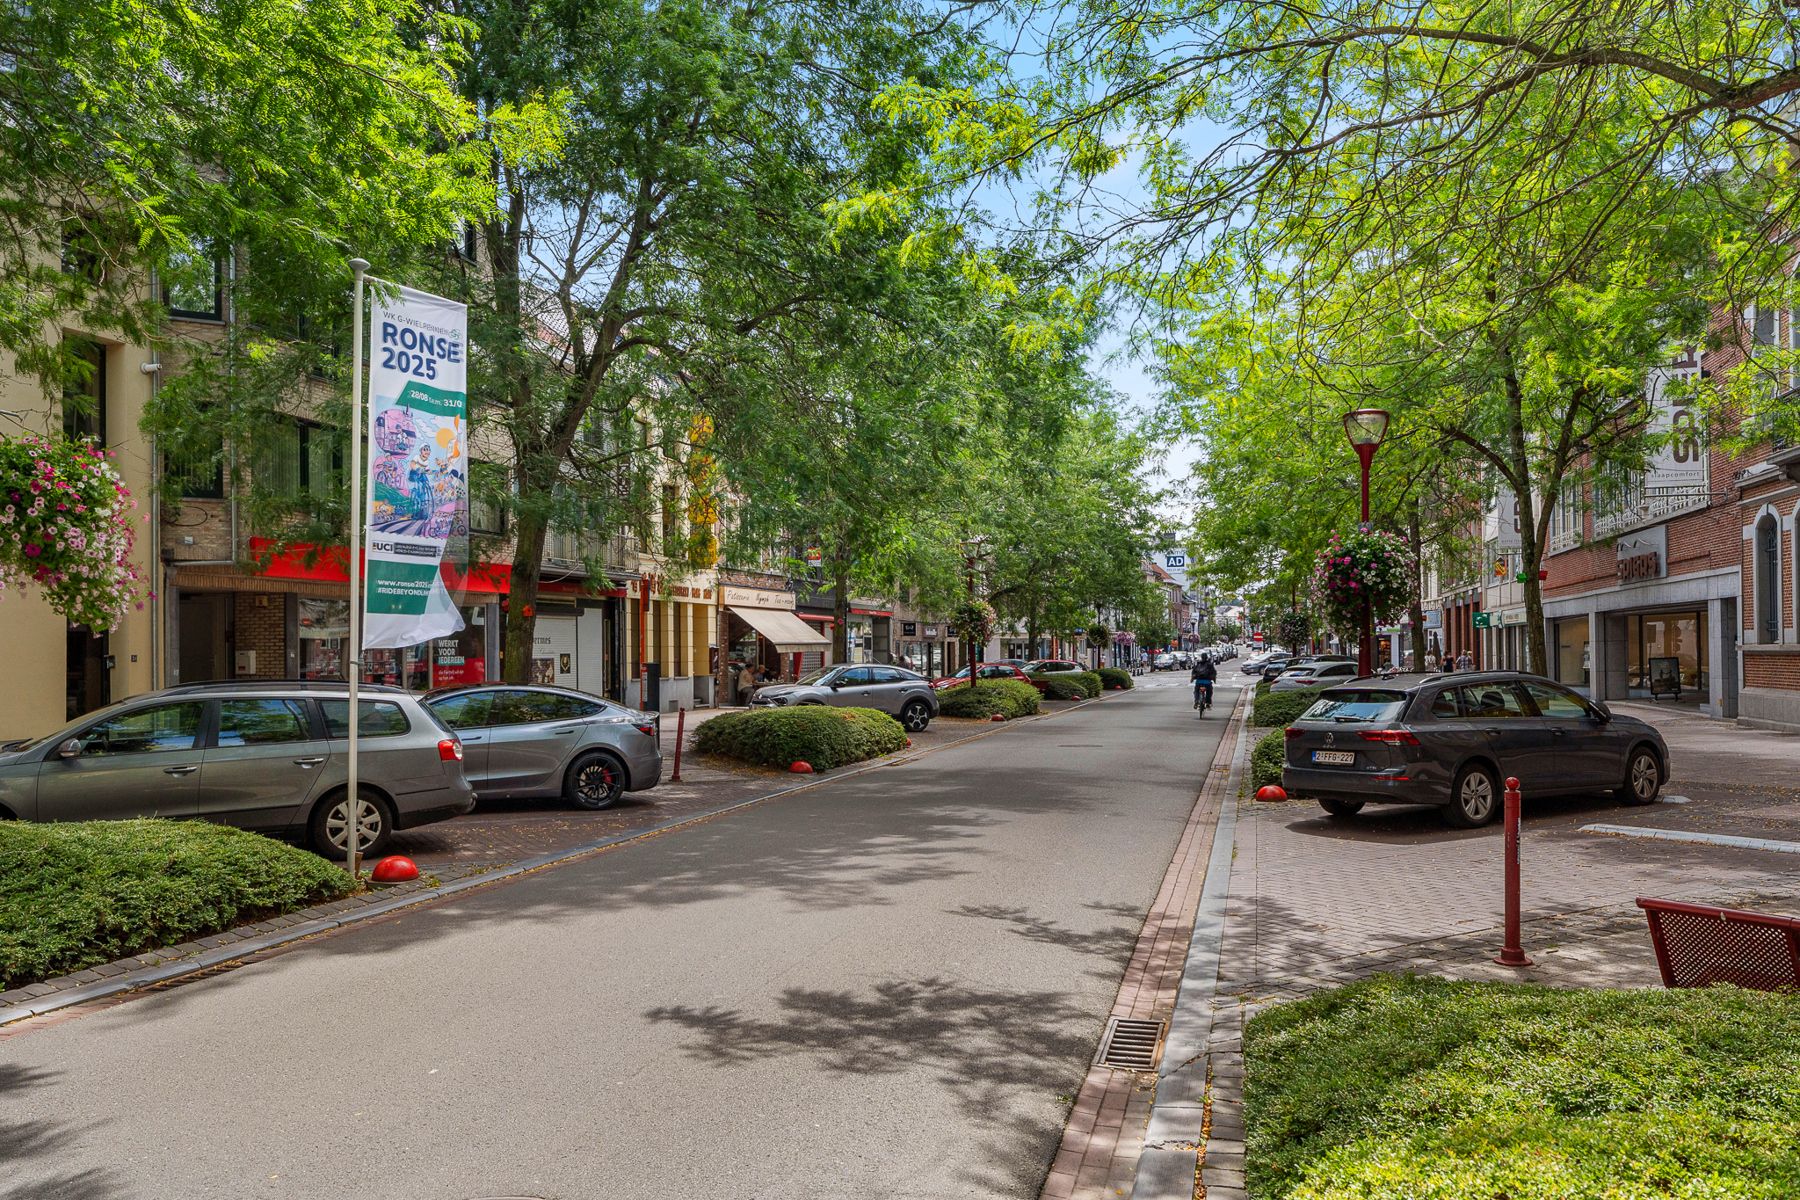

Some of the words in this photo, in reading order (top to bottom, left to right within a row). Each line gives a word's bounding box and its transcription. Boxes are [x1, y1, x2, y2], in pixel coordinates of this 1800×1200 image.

[383, 311, 396, 321] WK
[382, 321, 463, 363] RONSE
[382, 346, 437, 380] 2025
[377, 543, 393, 552] UCI
[1168, 556, 1184, 566] AD
[438, 656, 465, 664] IEDEREEN
